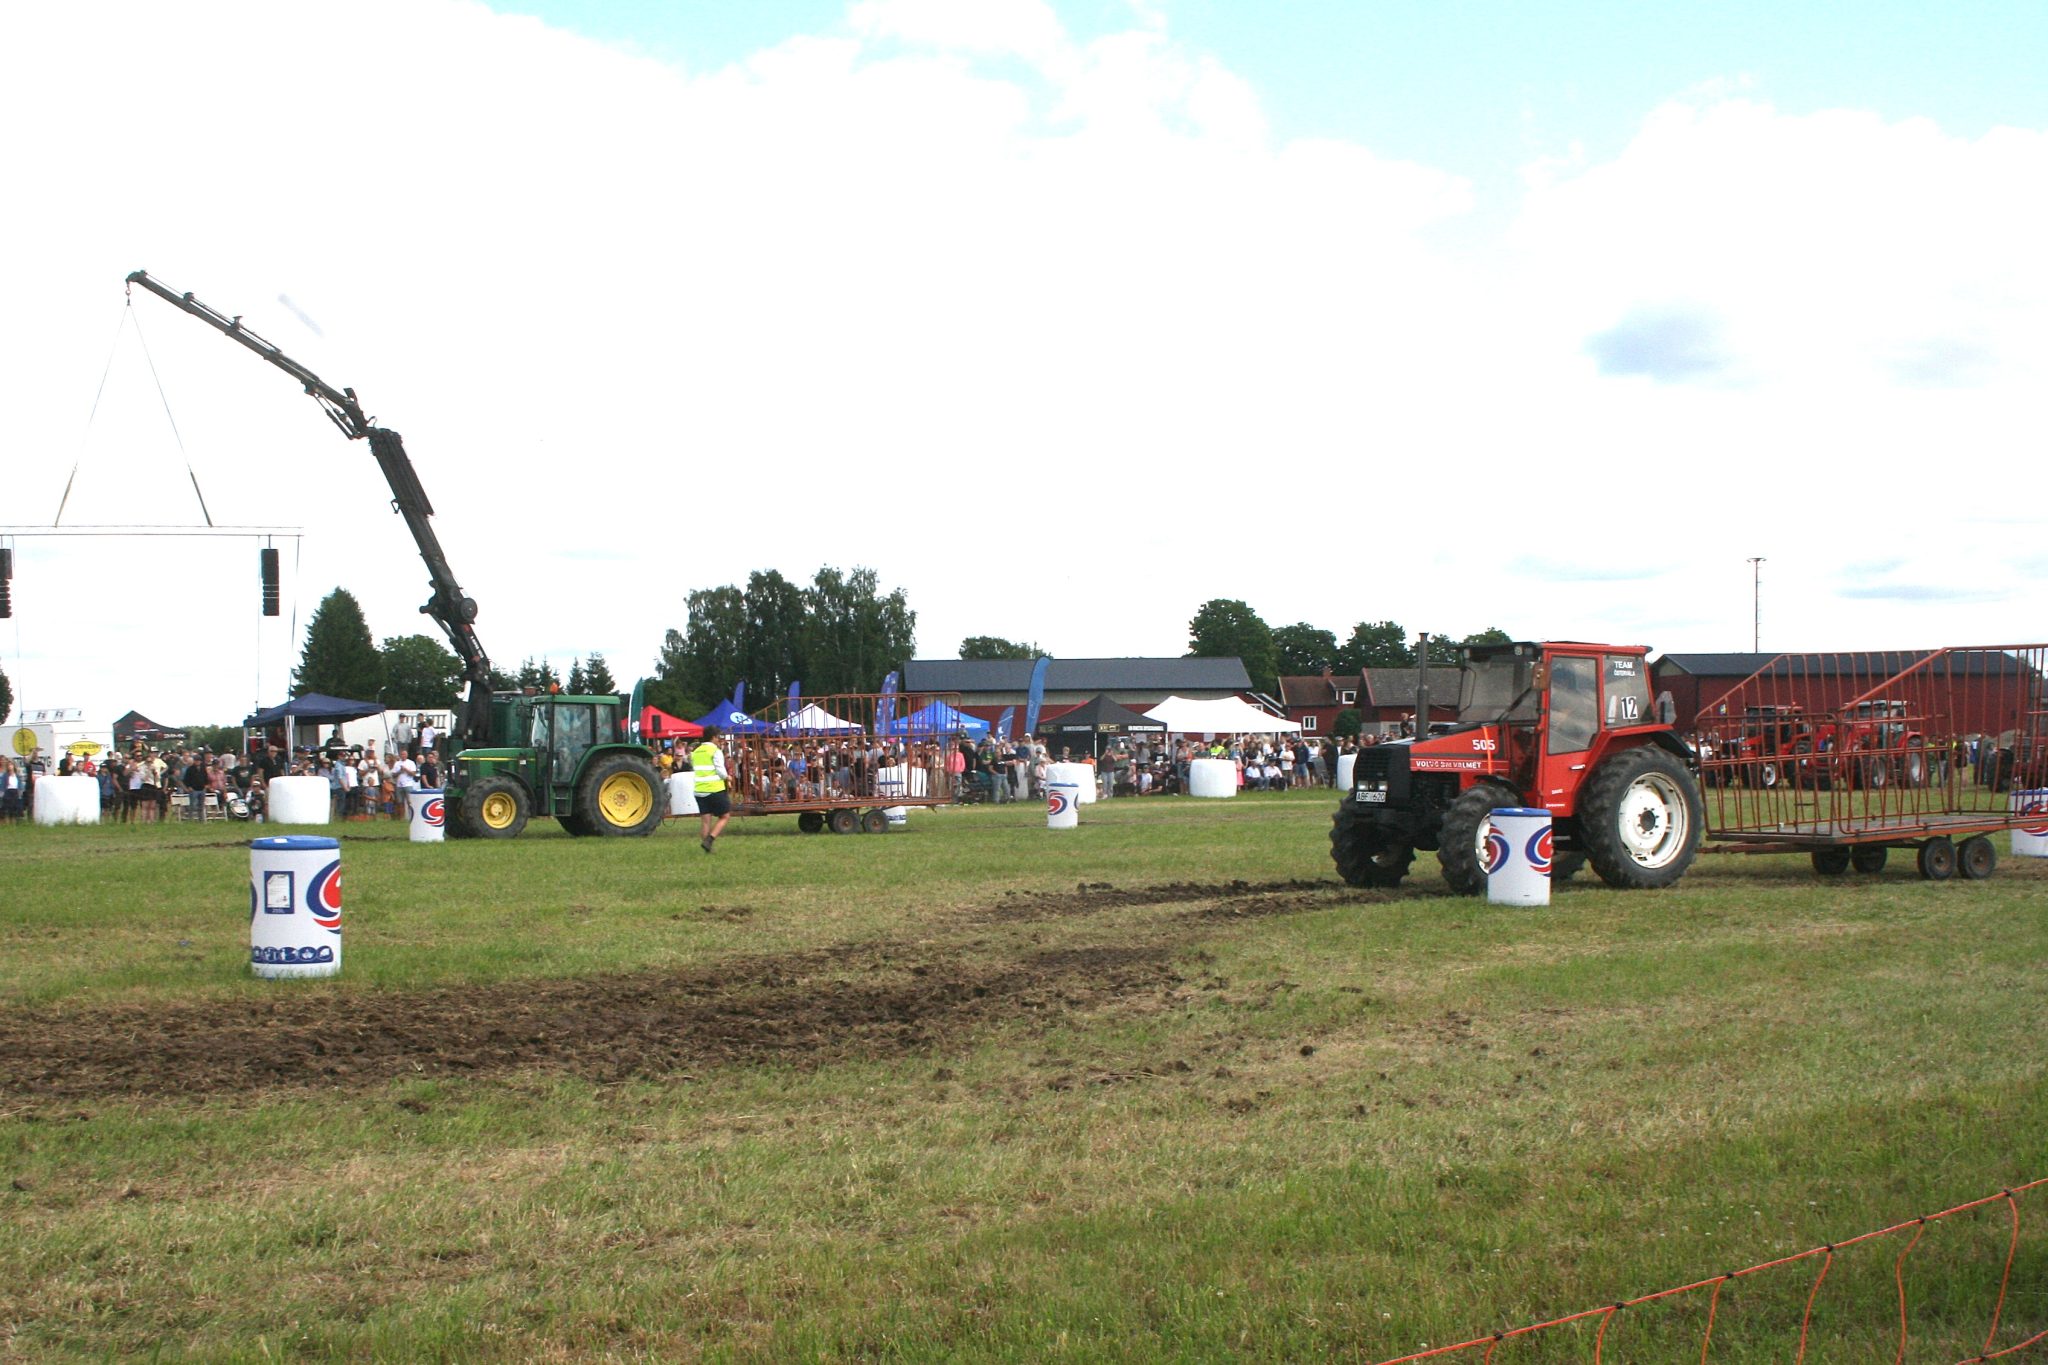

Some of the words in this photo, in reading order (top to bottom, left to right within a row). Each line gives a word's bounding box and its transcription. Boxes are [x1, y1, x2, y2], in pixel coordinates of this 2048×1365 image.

[1614, 660, 1633, 669] TEAM
[1621, 697, 1637, 718] 12
[1472, 739, 1496, 751] 505
[1415, 760, 1439, 768] VOLVO
[1453, 761, 1482, 769] VALMET
